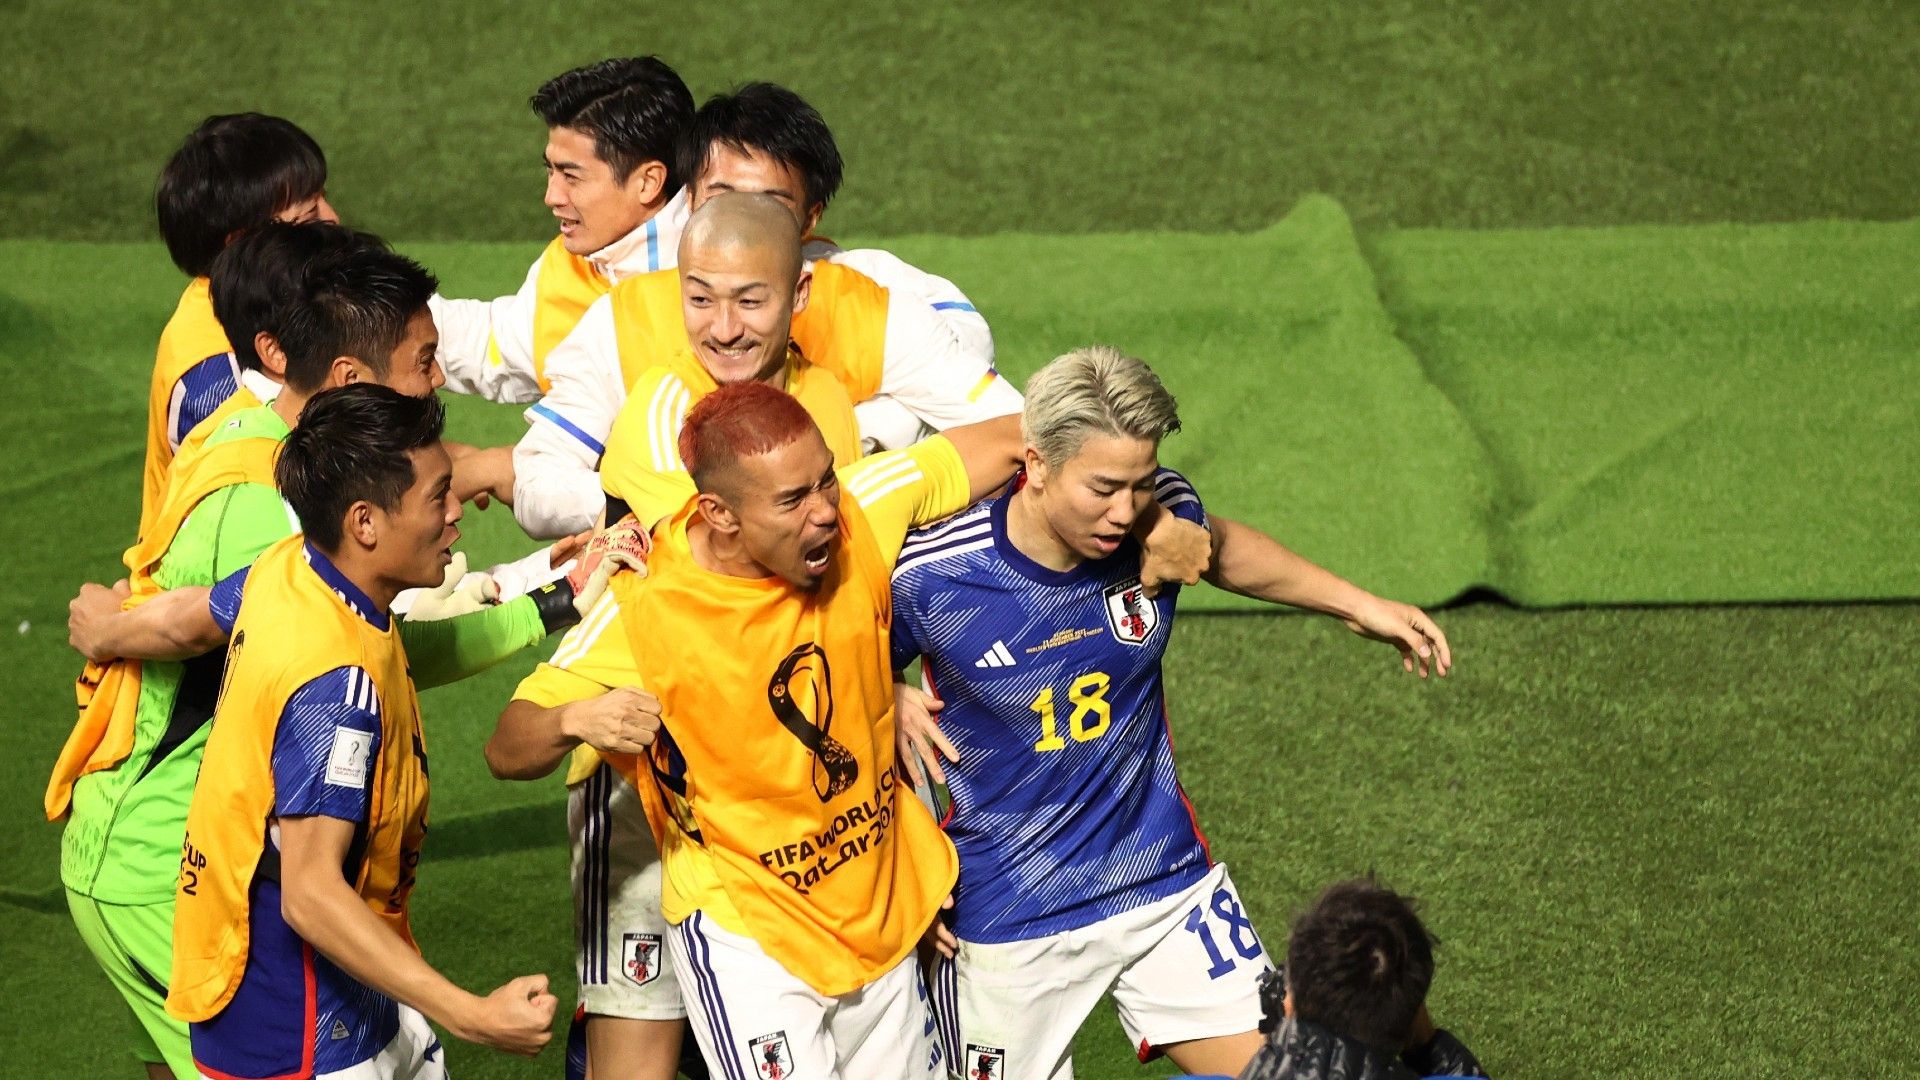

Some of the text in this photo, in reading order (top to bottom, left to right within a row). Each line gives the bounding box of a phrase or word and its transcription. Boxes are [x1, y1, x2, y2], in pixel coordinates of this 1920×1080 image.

[1114, 580, 1137, 593] JAPAN
[1029, 671, 1111, 753] 18
[759, 839, 816, 869] FIFA
[815, 788, 881, 849] WORLD
[1184, 888, 1262, 980] 18
[756, 1033, 777, 1044] JAPAN
[975, 1045, 996, 1053] JAPAN
